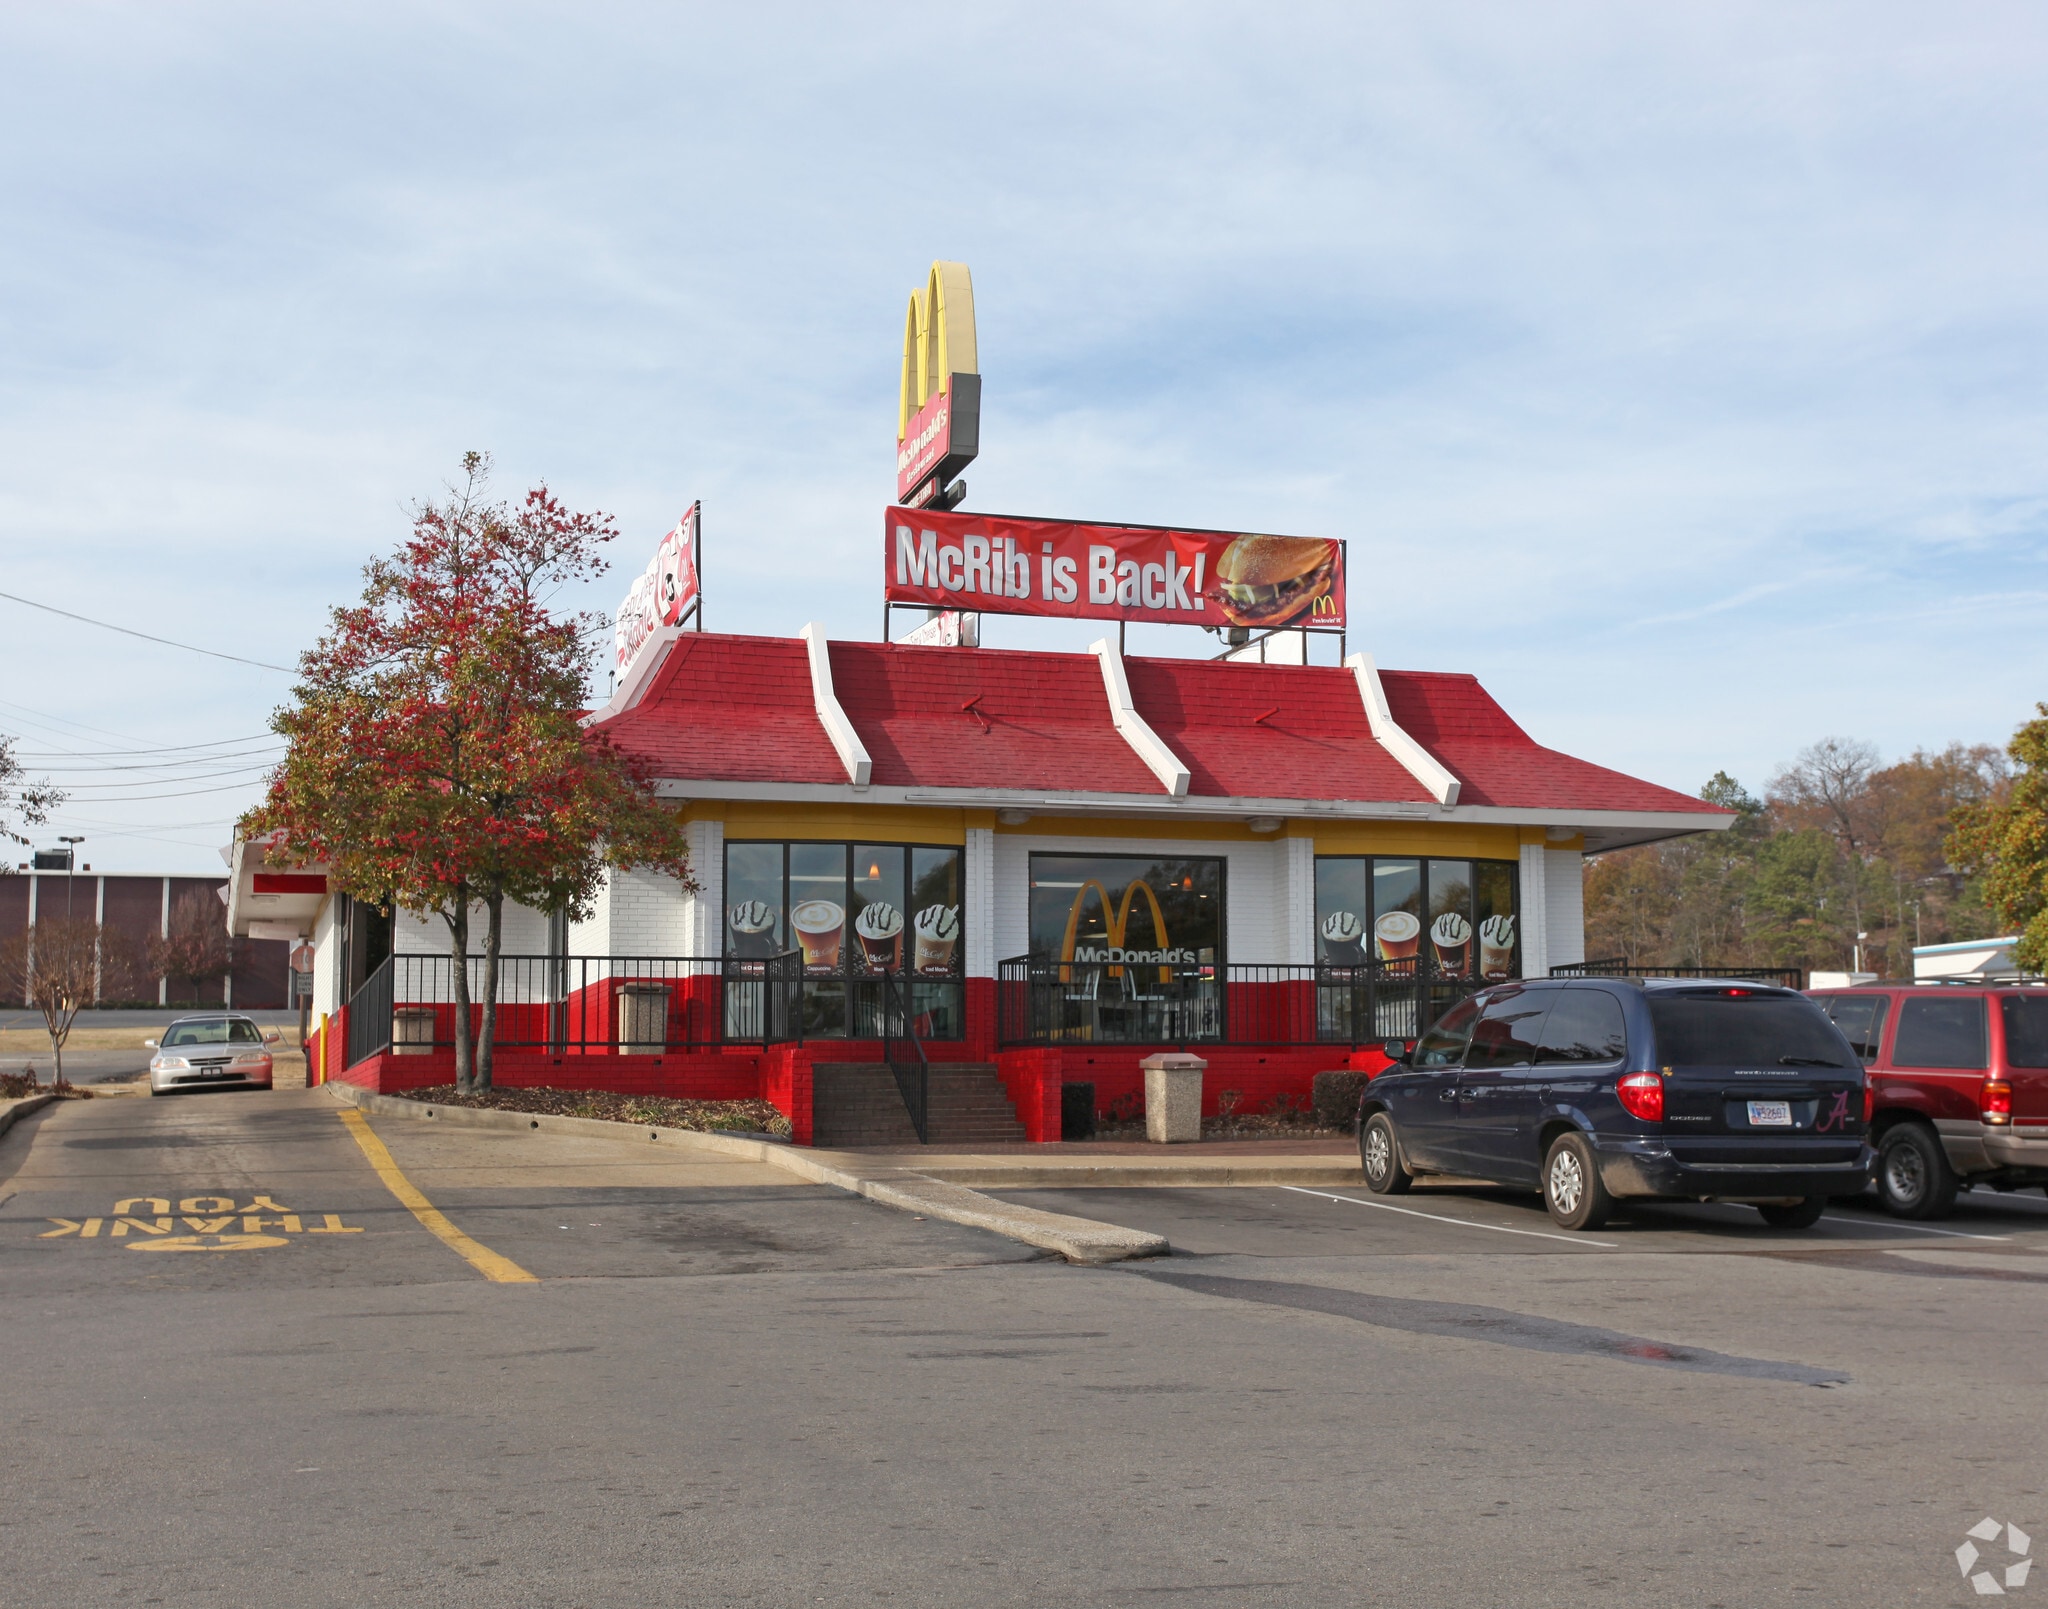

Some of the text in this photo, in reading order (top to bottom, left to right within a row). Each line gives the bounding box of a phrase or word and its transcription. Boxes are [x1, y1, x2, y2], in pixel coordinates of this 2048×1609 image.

[898, 407, 947, 475] McDonald's
[895, 525, 1206, 610] McRib is Back!
[1074, 946, 1196, 964] McDonald's
[112, 1195, 292, 1215] YOU
[36, 1214, 365, 1239] THANK
